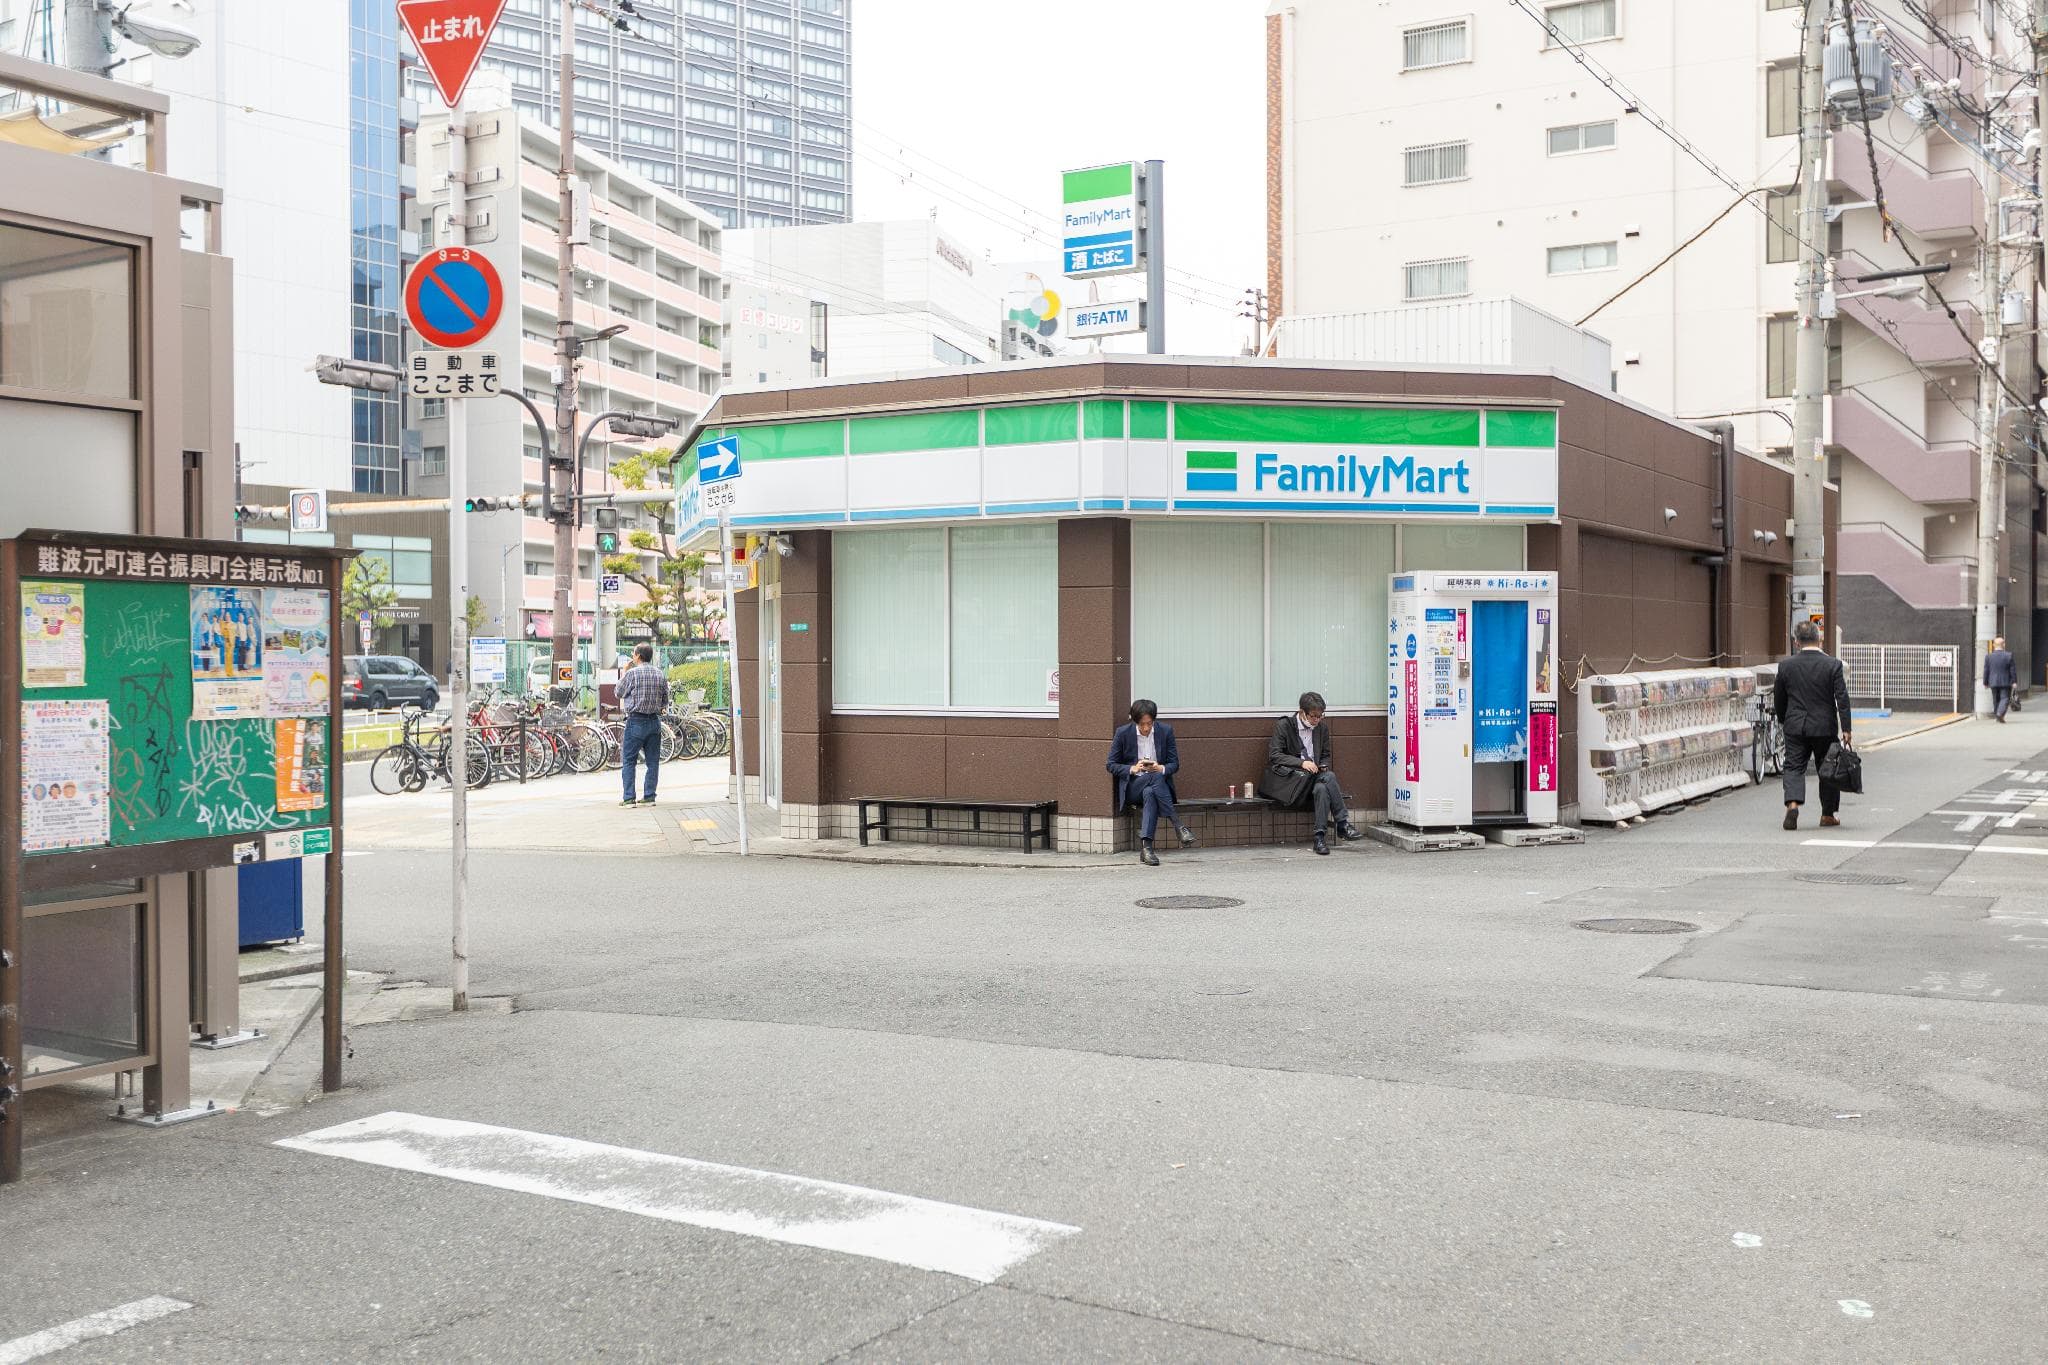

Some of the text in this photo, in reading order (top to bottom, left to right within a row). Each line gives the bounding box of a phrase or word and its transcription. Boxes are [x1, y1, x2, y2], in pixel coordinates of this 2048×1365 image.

[420, 14, 485, 45] 止まれ
[1065, 207, 1132, 227] FamilyMart
[1071, 249, 1125, 270] 酒 たばこ
[1076, 310, 1129, 327] 銀行ATM
[413, 354, 496, 371] 自動車
[413, 373, 498, 394] ここまで
[1254, 453, 1470, 498] FamilyMart
[38, 546, 302, 584] 難波元町連合振興町会掲示板
[1447, 578, 1482, 586] 証明写真
[1395, 788, 1411, 802] DNP
